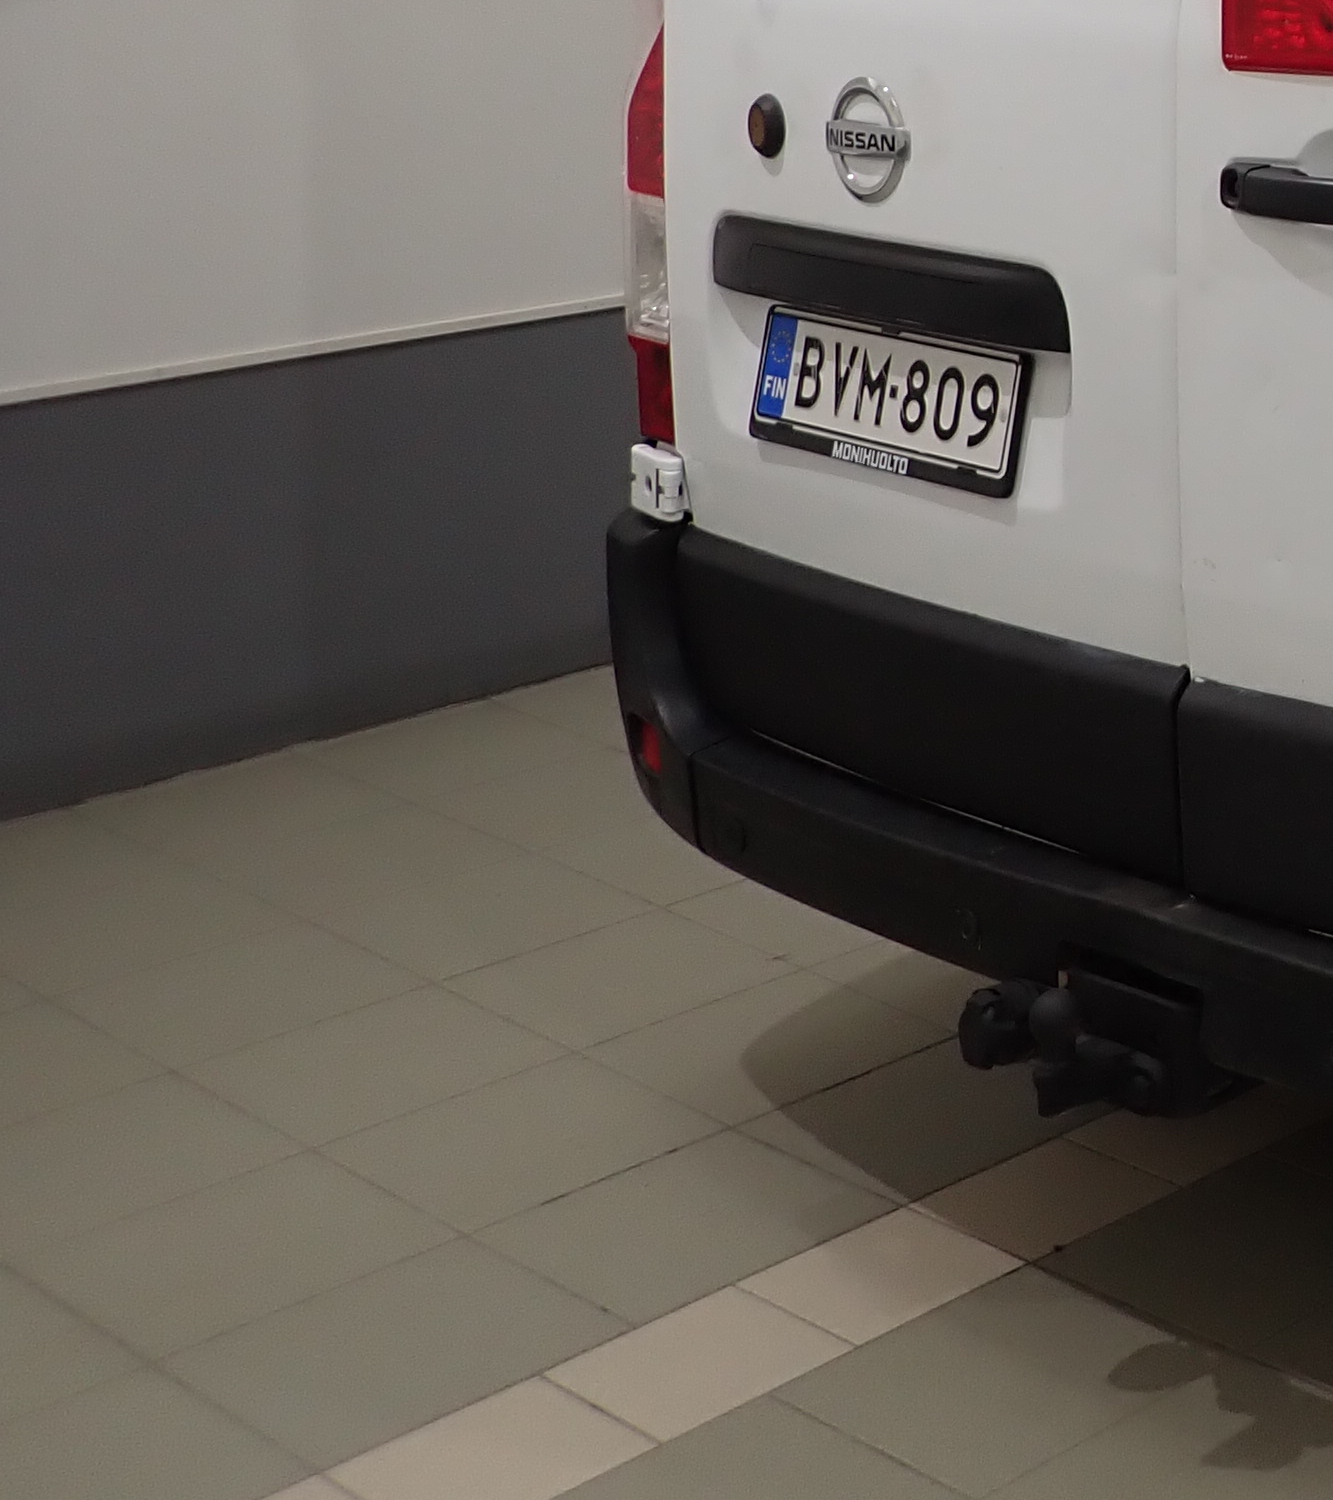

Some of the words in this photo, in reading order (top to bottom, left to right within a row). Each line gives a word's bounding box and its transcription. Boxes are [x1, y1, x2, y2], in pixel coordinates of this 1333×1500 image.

[829, 128, 896, 152] NISSAN
[763, 375, 787, 400] FIN
[794, 335, 1001, 448] BVM-809
[831, 441, 909, 475] MONIHUOLTO
